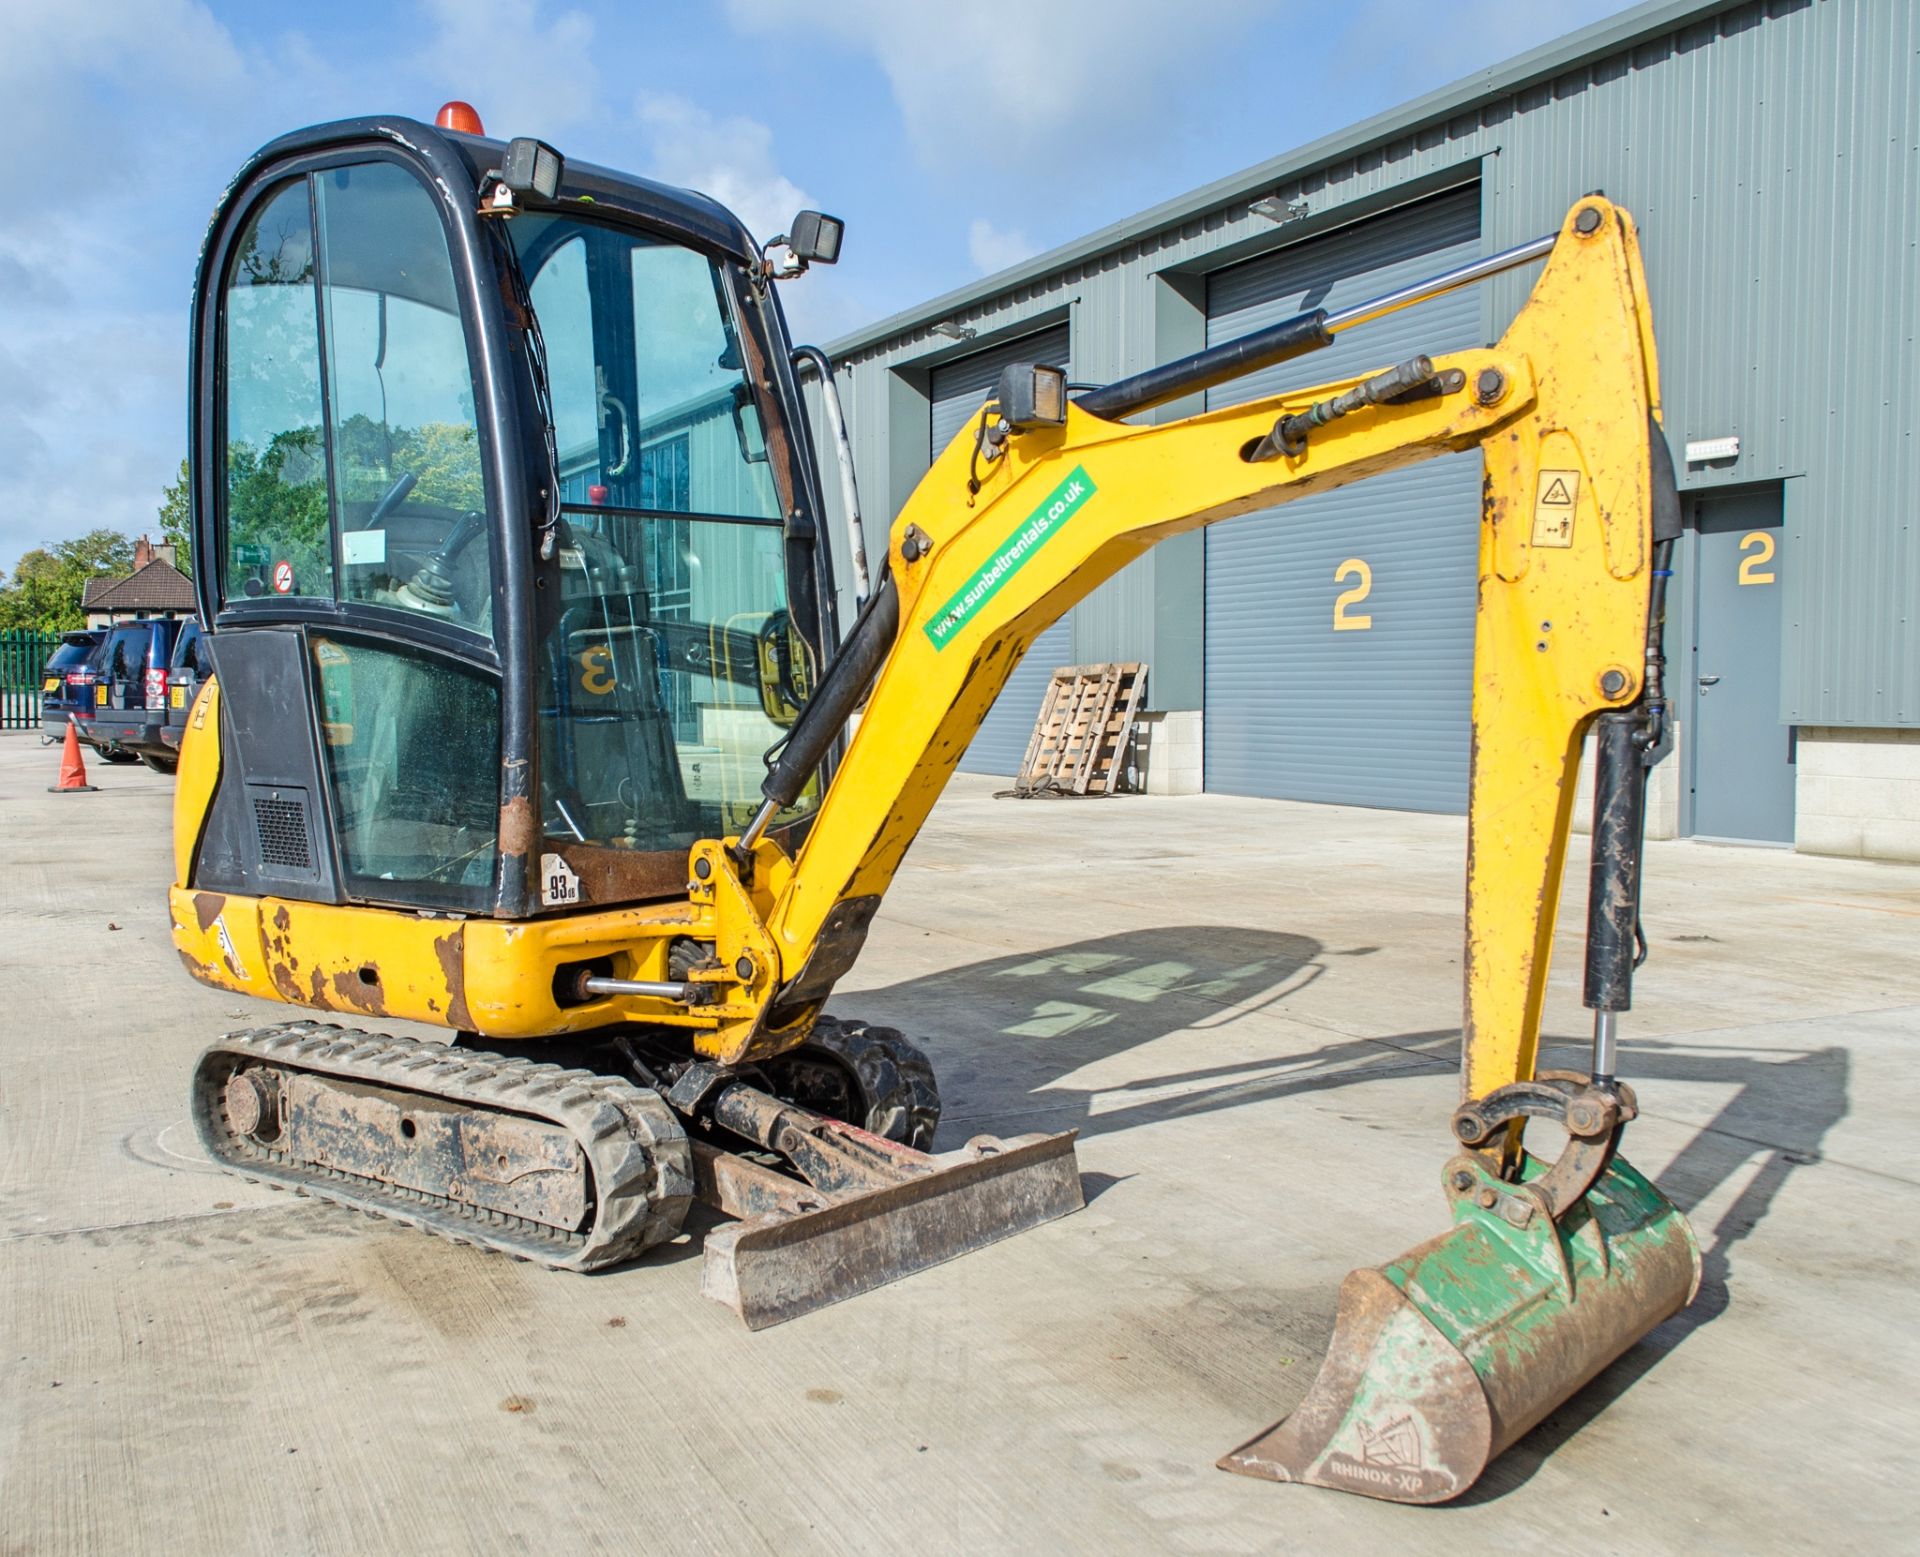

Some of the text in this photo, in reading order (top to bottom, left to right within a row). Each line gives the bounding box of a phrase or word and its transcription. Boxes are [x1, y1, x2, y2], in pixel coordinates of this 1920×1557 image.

[933, 480, 1085, 638] www.sunbeltrentals.co.uk
[1333, 558, 1372, 631] 2
[1739, 531, 1775, 586] 2
